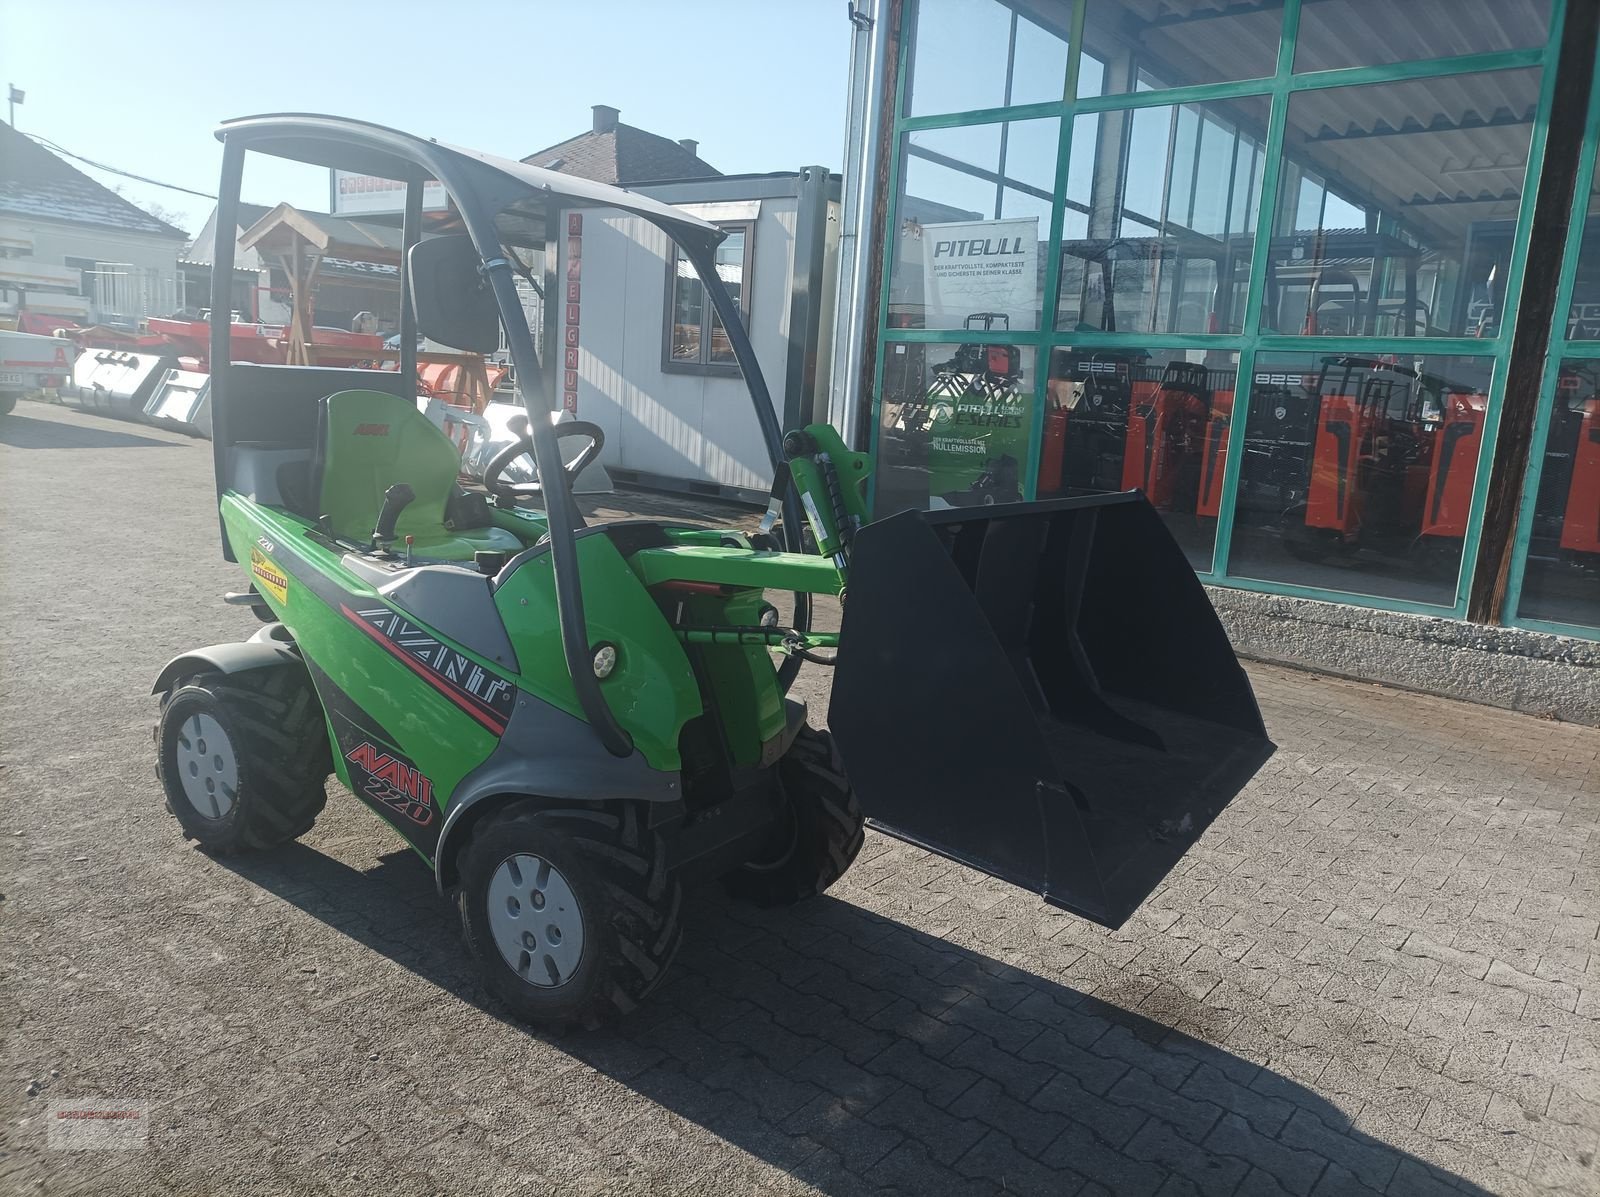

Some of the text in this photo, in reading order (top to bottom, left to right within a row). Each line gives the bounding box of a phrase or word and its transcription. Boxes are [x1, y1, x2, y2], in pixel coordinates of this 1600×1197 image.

[934, 237, 1025, 258] PITBULL
[933, 443, 986, 454] NULLEMISSION
[345, 742, 433, 807] AVANT
[364, 777, 433, 826] 220
